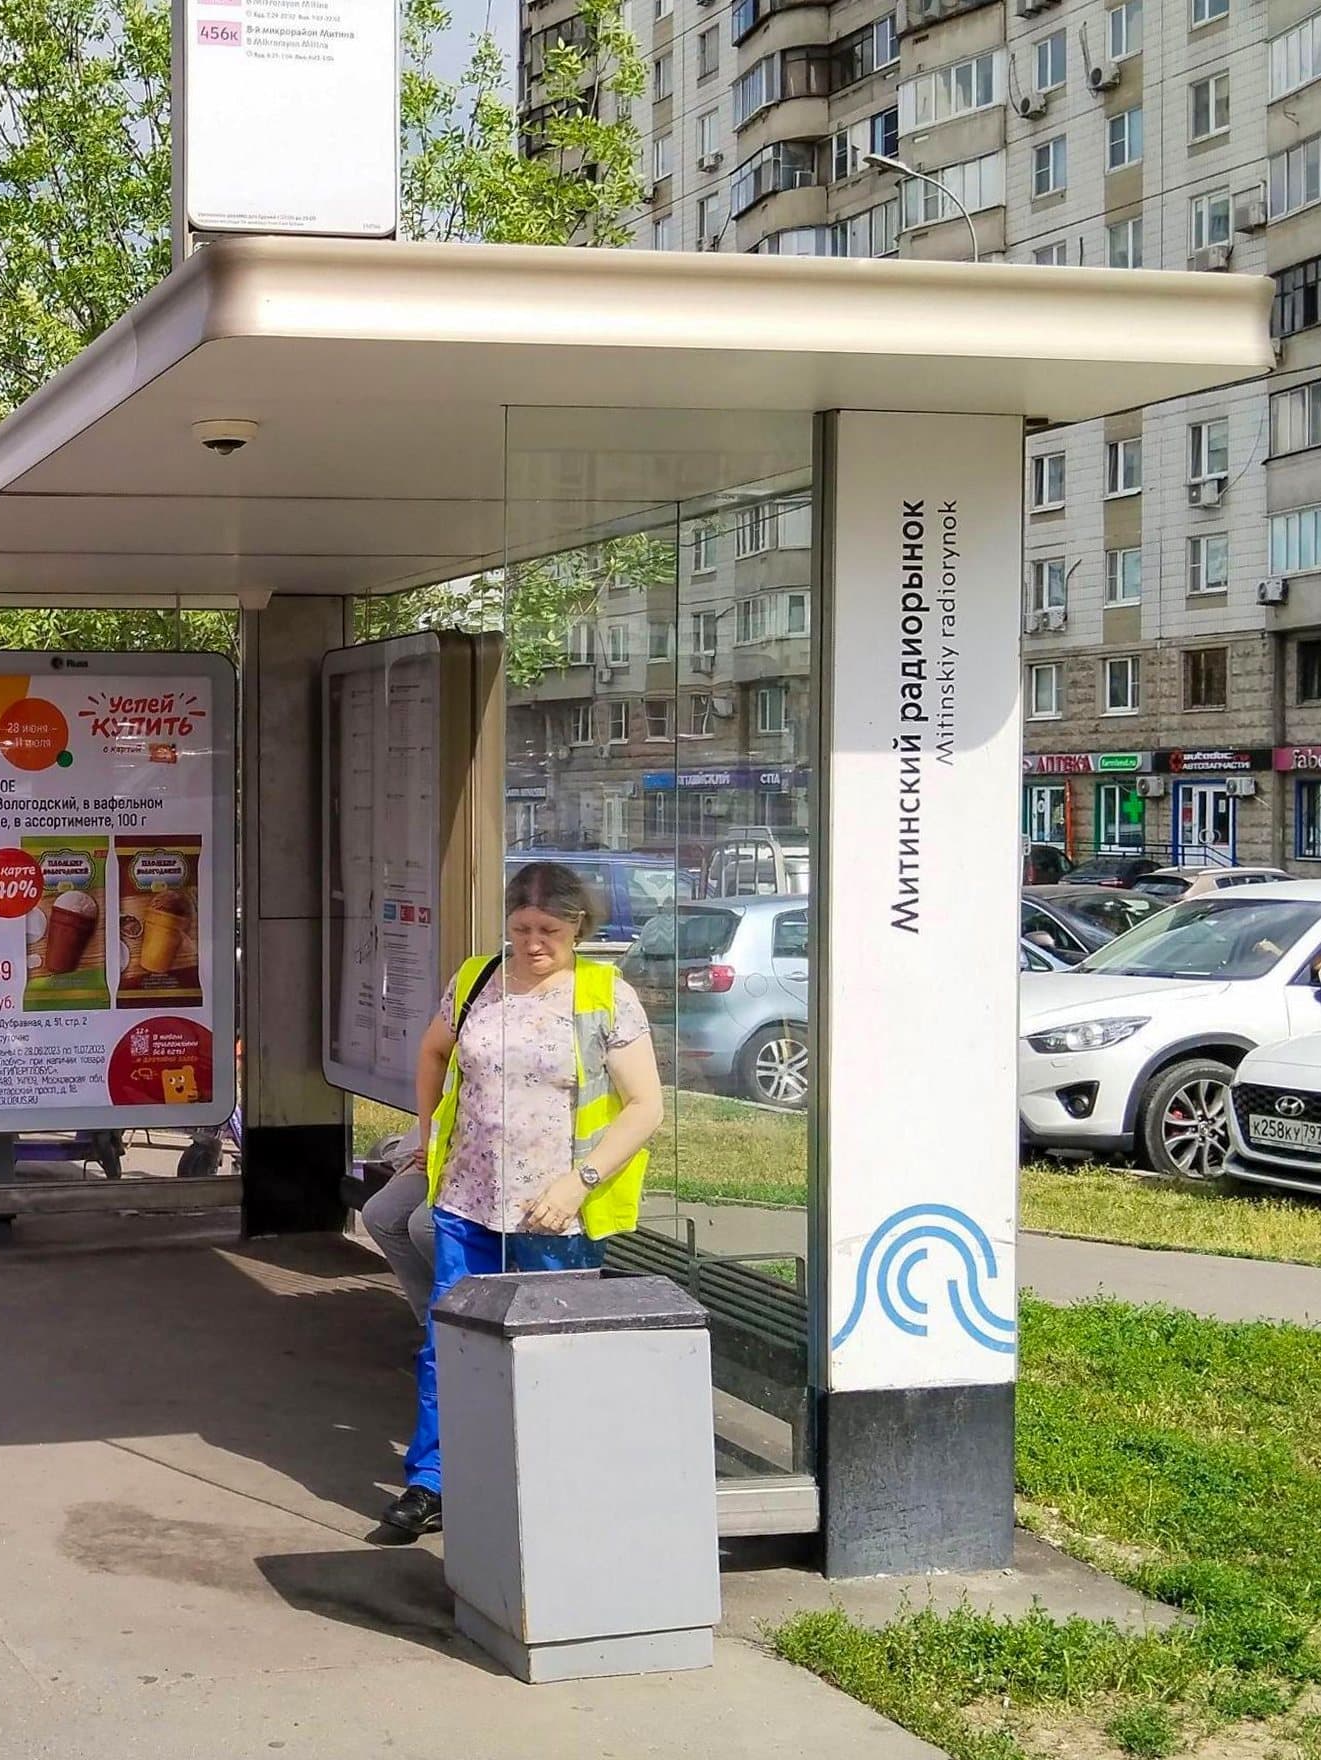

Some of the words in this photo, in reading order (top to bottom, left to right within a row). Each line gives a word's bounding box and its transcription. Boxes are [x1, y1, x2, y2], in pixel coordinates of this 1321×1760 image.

[263, 27, 318, 37] микрорайон
[320, 29, 355, 39] Митина
[936, 500, 960, 638] radiorynok
[900, 500, 930, 722] радиорынок
[936, 648, 960, 766] Mitinskiy
[7, 722, 20, 734] 28
[22, 724, 48, 734] июня
[1036, 754, 1093, 772] АПТЕКА
[759, 773, 780, 784] СПА
[83, 799, 90, 810] в
[94, 796, 163, 812] вафельном
[14, 817, 21, 827] в
[25, 815, 114, 829] ассортименте,
[118, 813, 137, 826] 100
[141, 816, 147, 826] г
[890, 734, 922, 934] Митинский
[0, 866, 36, 878] карте
